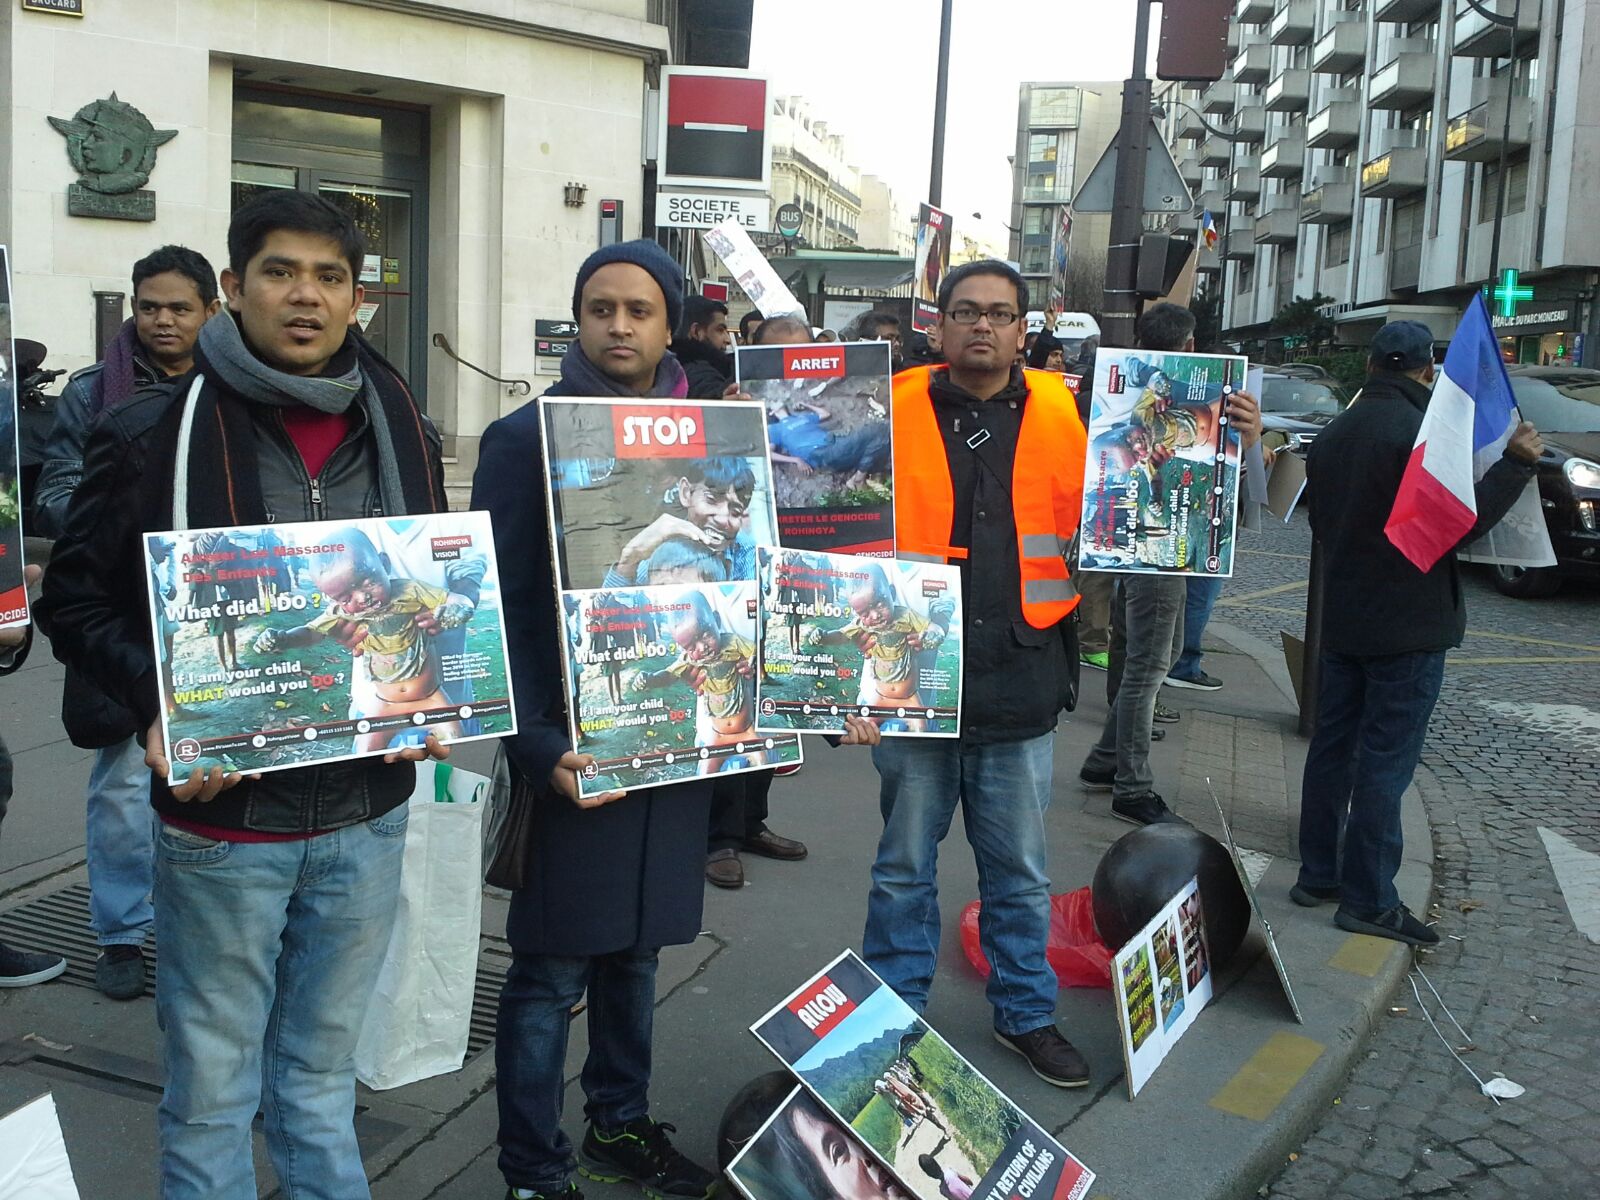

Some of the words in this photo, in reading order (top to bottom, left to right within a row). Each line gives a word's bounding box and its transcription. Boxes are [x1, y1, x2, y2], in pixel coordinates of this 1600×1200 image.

[32, 0, 76, 9] ROCARD
[669, 198, 741, 213] SOCIETE
[668, 211, 756, 226] GENERLE
[780, 211, 800, 222] BUS
[930, 211, 943, 225] STOP
[1057, 320, 1086, 328] CAR
[791, 357, 839, 371] ARRET
[622, 415, 697, 446] STOP
[1181, 470, 1192, 486] DO
[1129, 480, 1139, 499] DO
[1182, 487, 1191, 505] you
[1169, 489, 1178, 513] child
[816, 514, 827, 523] LE
[830, 512, 881, 522] GENOCIDE
[1126, 509, 1138, 530] did
[1169, 514, 1178, 537] your
[1179, 507, 1189, 535] would
[784, 526, 837, 536] ROHINGYA
[273, 543, 345, 557] Massacre
[433, 538, 469, 547] ROHINGYA
[1124, 532, 1137, 565] What
[1168, 536, 1176, 551] am
[434, 550, 459, 558] VISION
[1177, 537, 1186, 568] WHAT
[165, 604, 222, 622] What
[226, 598, 258, 616] did
[277, 595, 307, 612] DO
[763, 600, 794, 614] What
[795, 602, 815, 616] did
[824, 605, 841, 617] DO
[574, 650, 612, 664] What
[613, 647, 636, 662] did
[647, 644, 667, 658] DO
[792, 654, 812, 663] your
[813, 653, 834, 664] child
[198, 673, 222, 684] am
[225, 668, 262, 684] your
[265, 660, 301, 676] child
[763, 664, 792, 673] WHAT
[793, 666, 819, 675] would
[820, 669, 836, 678] you
[837, 667, 852, 678] DO
[173, 687, 224, 705] WHAT
[228, 681, 276, 698] would
[279, 680, 308, 695] you
[311, 674, 334, 687] DO
[595, 707, 613, 715] am
[613, 703, 638, 715] your
[639, 698, 664, 710] child
[580, 719, 613, 732] WHAT
[616, 714, 648, 728] would
[648, 714, 668, 726] you
[669, 709, 686, 721] DO
[797, 983, 848, 1030] ALLOW
[996, 1152, 1030, 1195] RETURN
[1021, 1139, 1037, 1159] OF
[1017, 1148, 1055, 1199] CIVILIANS
[1067, 1169, 1091, 1200] GENOCIDE
